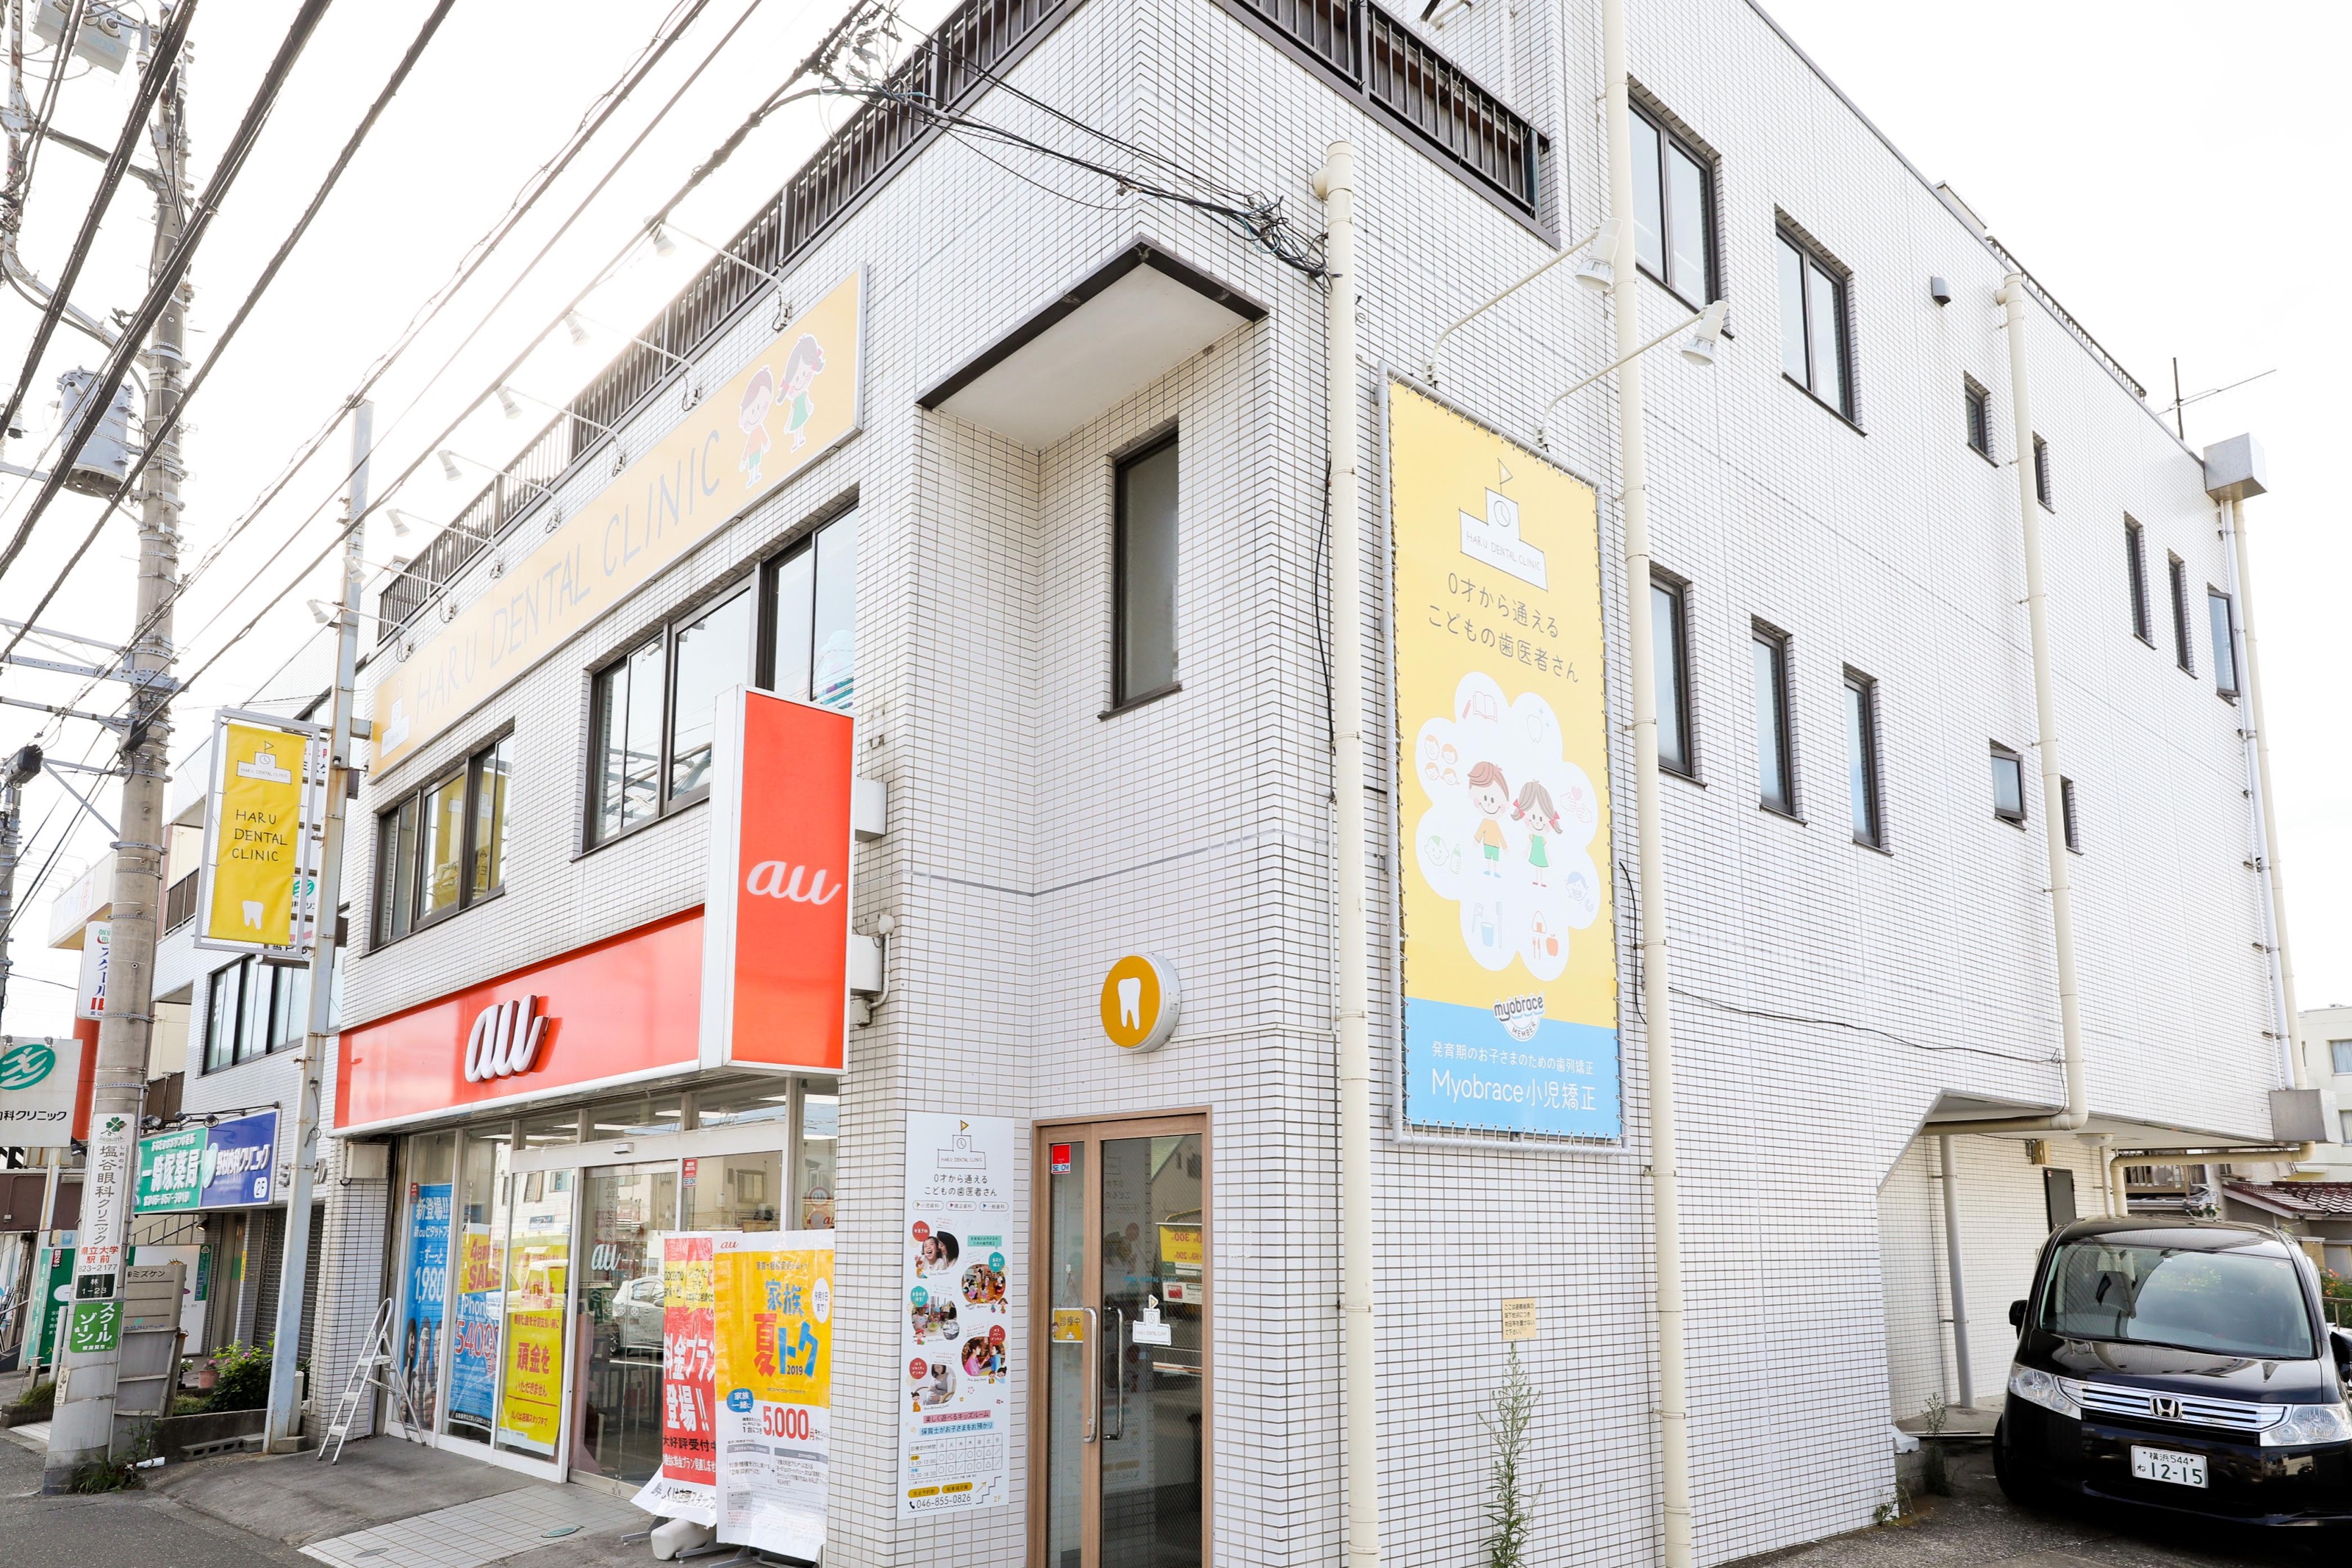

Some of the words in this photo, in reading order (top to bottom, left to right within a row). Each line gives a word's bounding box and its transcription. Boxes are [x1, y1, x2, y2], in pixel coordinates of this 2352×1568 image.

[1466, 531, 1488, 550] HARU
[1491, 542, 1517, 563] DENTAL
[1519, 555, 1542, 572] CLINIC
[415, 628, 478, 725] HARU
[490, 543, 592, 669] DENTAL
[603, 429, 721, 578] CLINIC
[1448, 572, 1559, 639] 0才から通える
[1429, 605, 1580, 683] こどもの歯医者さん
[235, 809, 277, 825] HARU
[234, 828, 288, 846] DENTAL
[232, 848, 279, 862] CLINIC
[746, 860, 842, 905] au
[1494, 996, 1544, 1022] myobrace
[1511, 1021, 1537, 1037] MEMBER
[465, 994, 550, 1083] au
[1432, 1040, 1594, 1076] 発育期のお子さまのための歯列矯正
[0, 1110, 67, 1121] 科クリニック
[933, 1173, 989, 1184] 0才から通える
[93, 1145, 118, 1245] 塩谷眼科クリニック
[256, 1180, 265, 1195] 2F
[924, 1187, 997, 1197] こどもの歯医者さん
[81, 1245, 119, 1255] 県立大学
[720, 1241, 739, 1249] au
[86, 1255, 110, 1264] 駅前
[591, 1243, 622, 1271] au
[78, 1264, 118, 1273] 823-2177
[467, 1261, 501, 1291] SALE
[90, 1278, 99, 1286] 林
[764, 1278, 805, 1317] 家族
[76, 1312, 98, 1344] ゾーン
[96, 1302, 115, 1343] スクール
[1060, 1316, 1081, 1327] 診療中
[516, 1342, 551, 1375] 頭金を
[786, 1364, 803, 1375] 2019
[514, 1381, 548, 1398] いただきません
[734, 1391, 750, 1400] 家族
[763, 1405, 809, 1441] 5,000
[925, 1412, 989, 1423] 楽しく遊べるキッズルーム
[921, 1422, 994, 1436] 保育士がお子さまをお預かり
[2136, 1464, 2146, 1472] ね
[2151, 1461, 2203, 1485] 12-15
[916, 1494, 971, 1508] 046-855-0826
